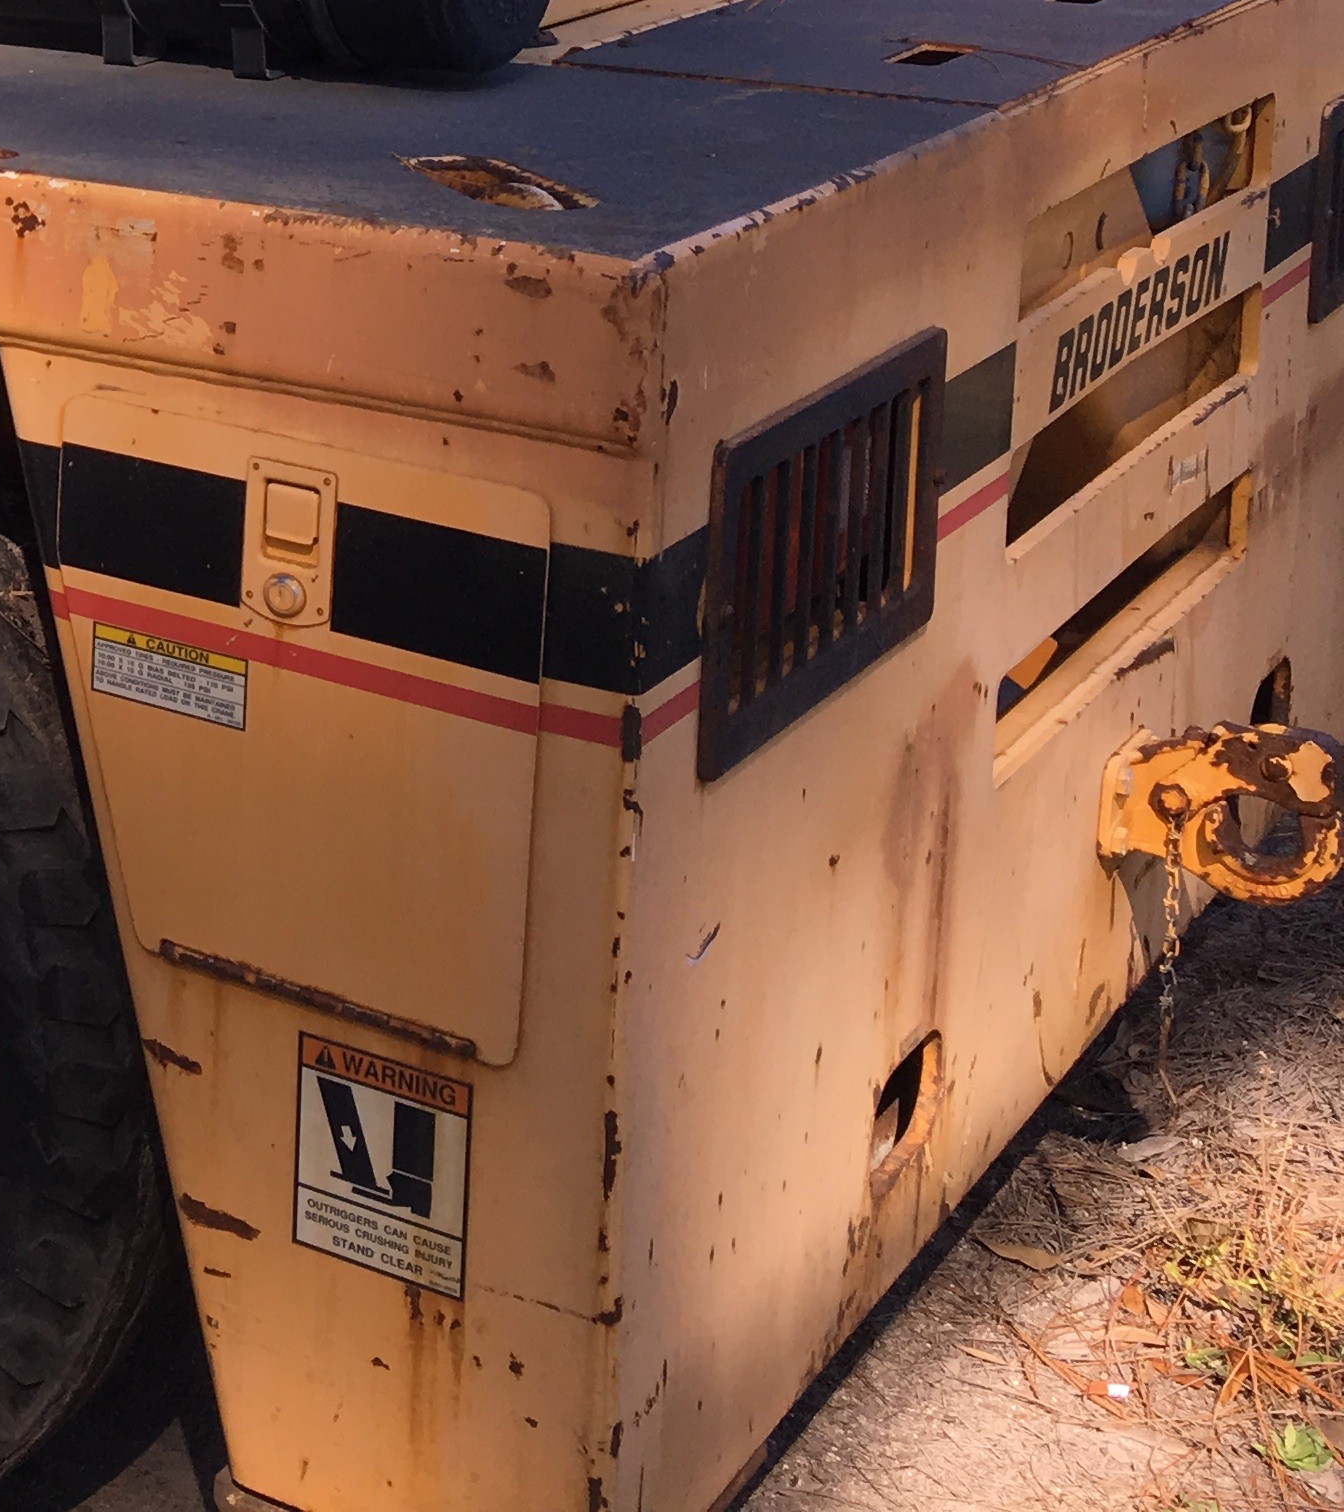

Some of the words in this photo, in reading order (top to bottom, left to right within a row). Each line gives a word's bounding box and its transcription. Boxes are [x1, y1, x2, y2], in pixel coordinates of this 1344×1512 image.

[1047, 229, 1232, 415] BRODERSON
[96, 641, 132, 656] APPROVED
[145, 637, 210, 664] CAUTION
[342, 1051, 457, 1107] WARNING
[304, 1210, 350, 1235] SERIOUS
[354, 1229, 410, 1255] CRUSHING
[414, 1248, 453, 1270] INJURY
[306, 1198, 379, 1231] OUTRIGGERS
[383, 1225, 408, 1240] CAN
[412, 1235, 452, 1257] CAUSE
[332, 1235, 375, 1259] STAND
[380, 1252, 424, 1277] CLEAR
